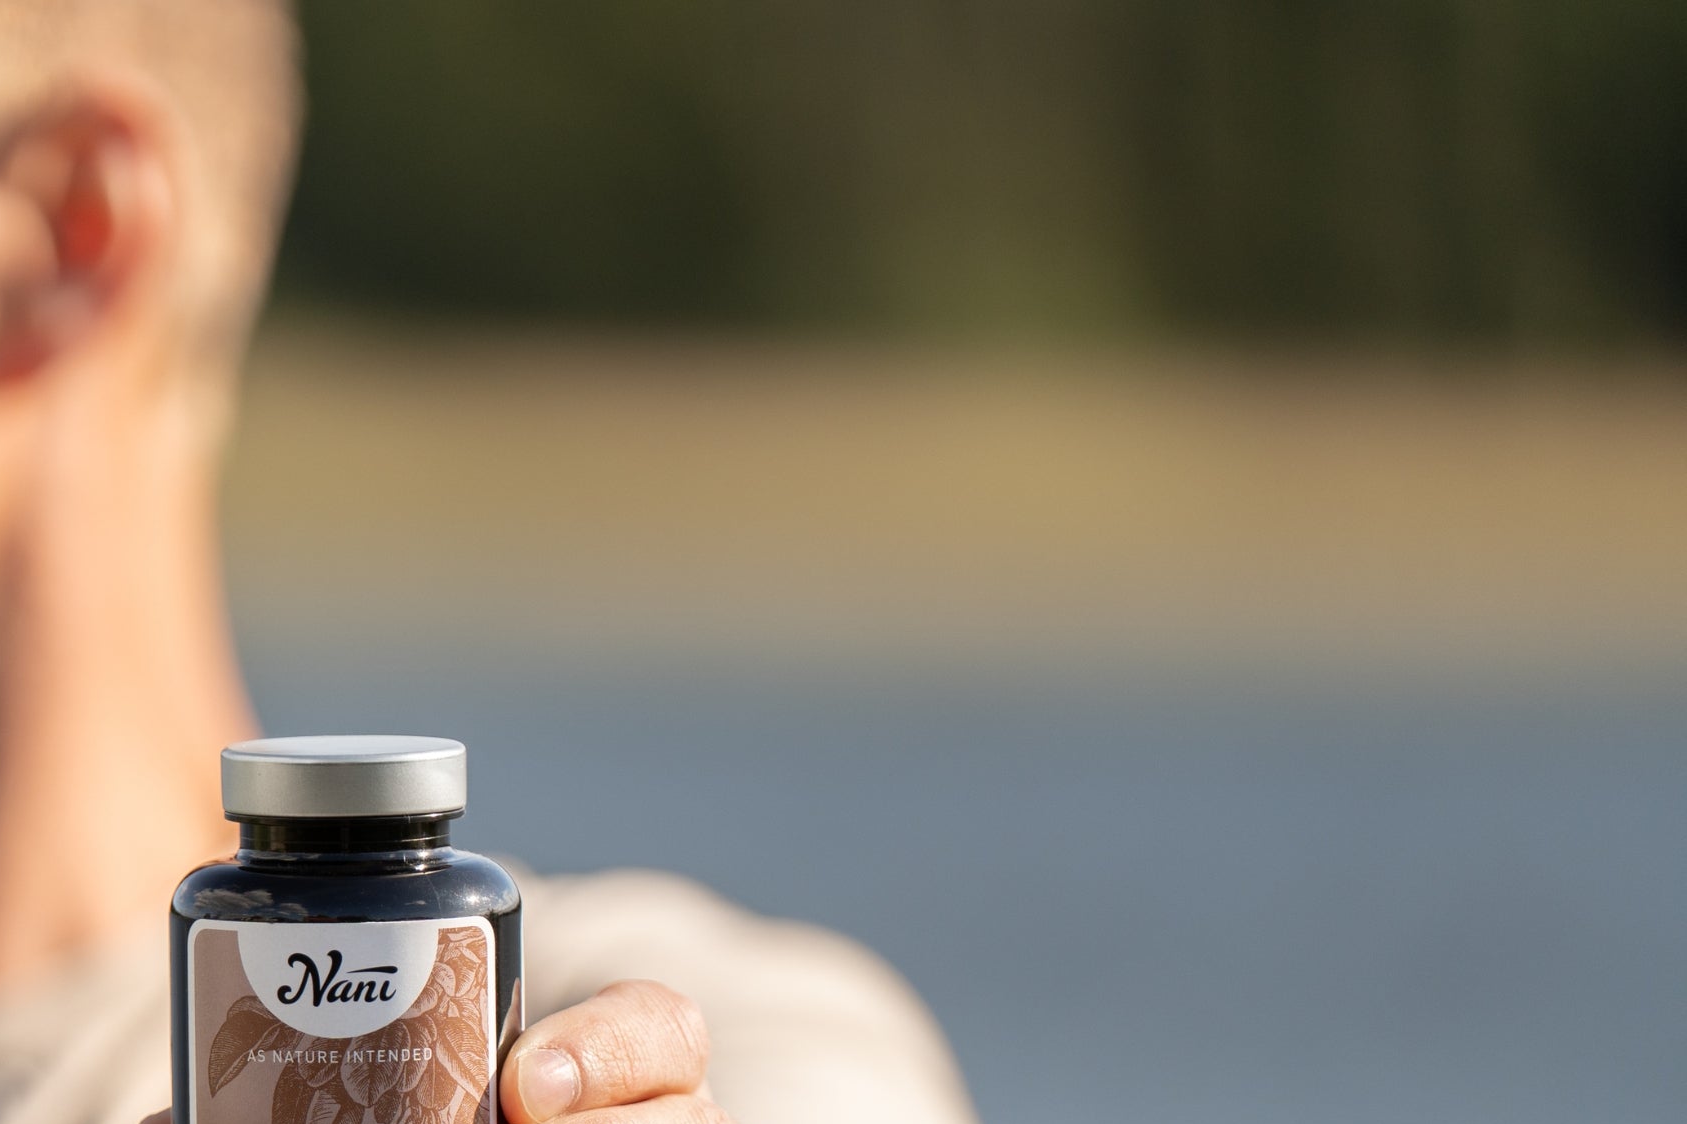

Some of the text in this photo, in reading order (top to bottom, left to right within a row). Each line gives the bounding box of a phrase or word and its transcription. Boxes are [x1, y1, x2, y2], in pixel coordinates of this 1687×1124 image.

[247, 1047, 433, 1064] AS NATURE INTENDED
